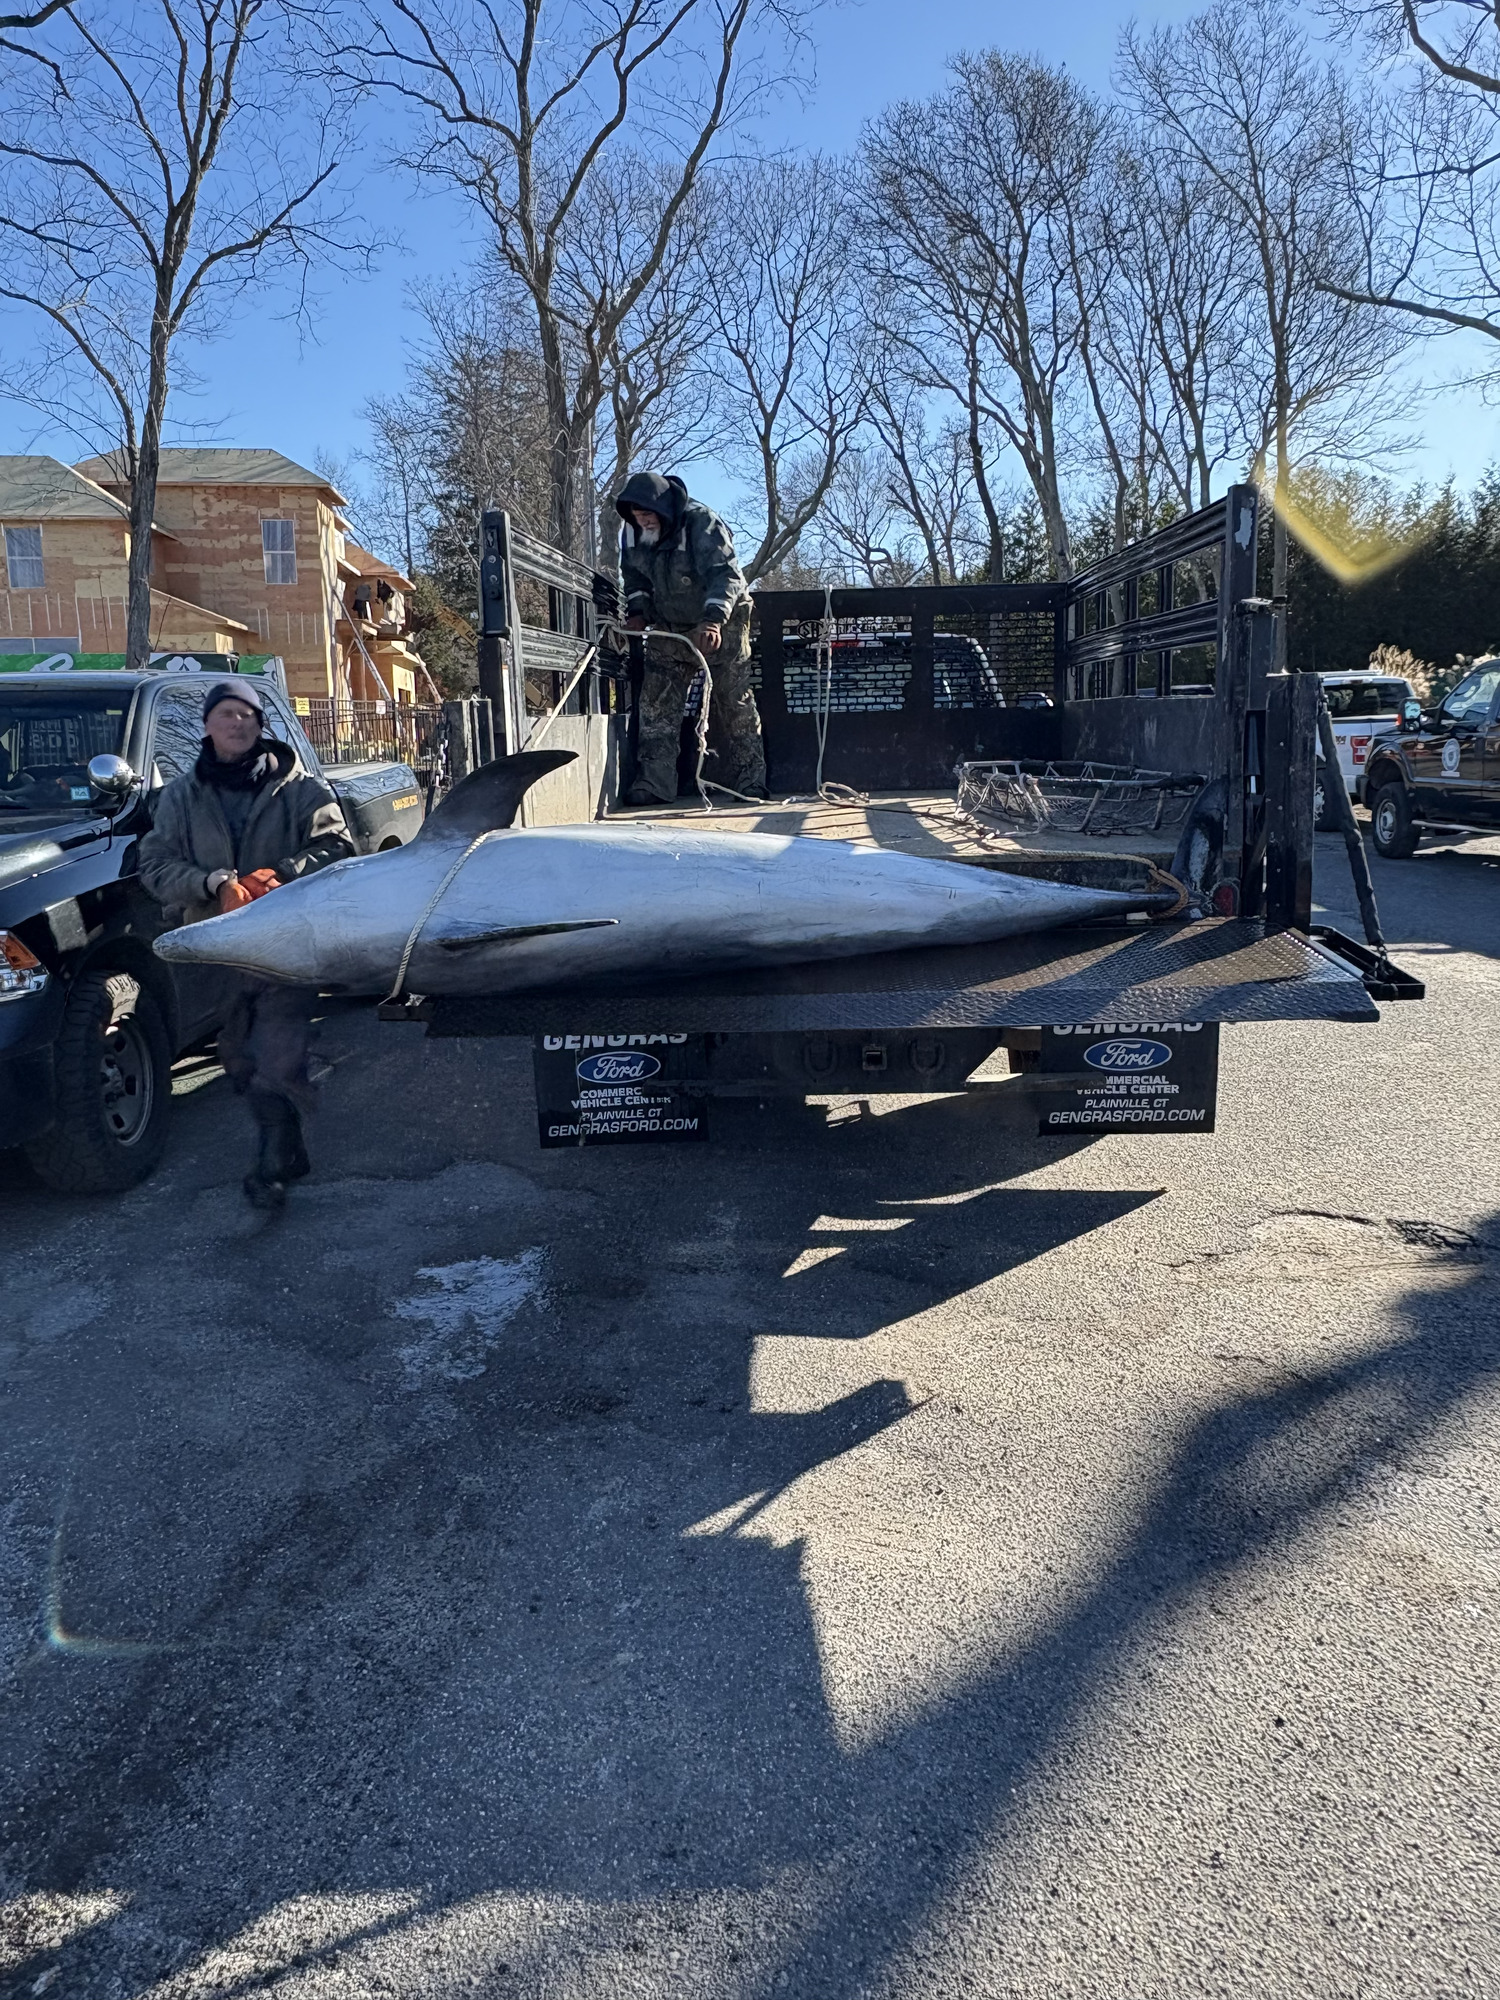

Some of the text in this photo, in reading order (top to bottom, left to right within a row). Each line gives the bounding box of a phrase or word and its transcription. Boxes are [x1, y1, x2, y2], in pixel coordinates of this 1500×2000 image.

[1100, 1042, 1156, 1066] Ford
[592, 1056, 645, 1079] Ford
[1105, 1075, 1169, 1085] MMERCIAL
[580, 1086, 642, 1099] COMMERC
[1130, 1084, 1180, 1095] CENTER
[571, 1097, 622, 1109] VEHICLE
[1084, 1098, 1169, 1109] PLAINVILLE, CT
[648, 1108, 662, 1118] CT
[1048, 1109, 1206, 1124] GENGRASFORD.COM
[548, 1118, 699, 1138] GENGRASFORD.COM
